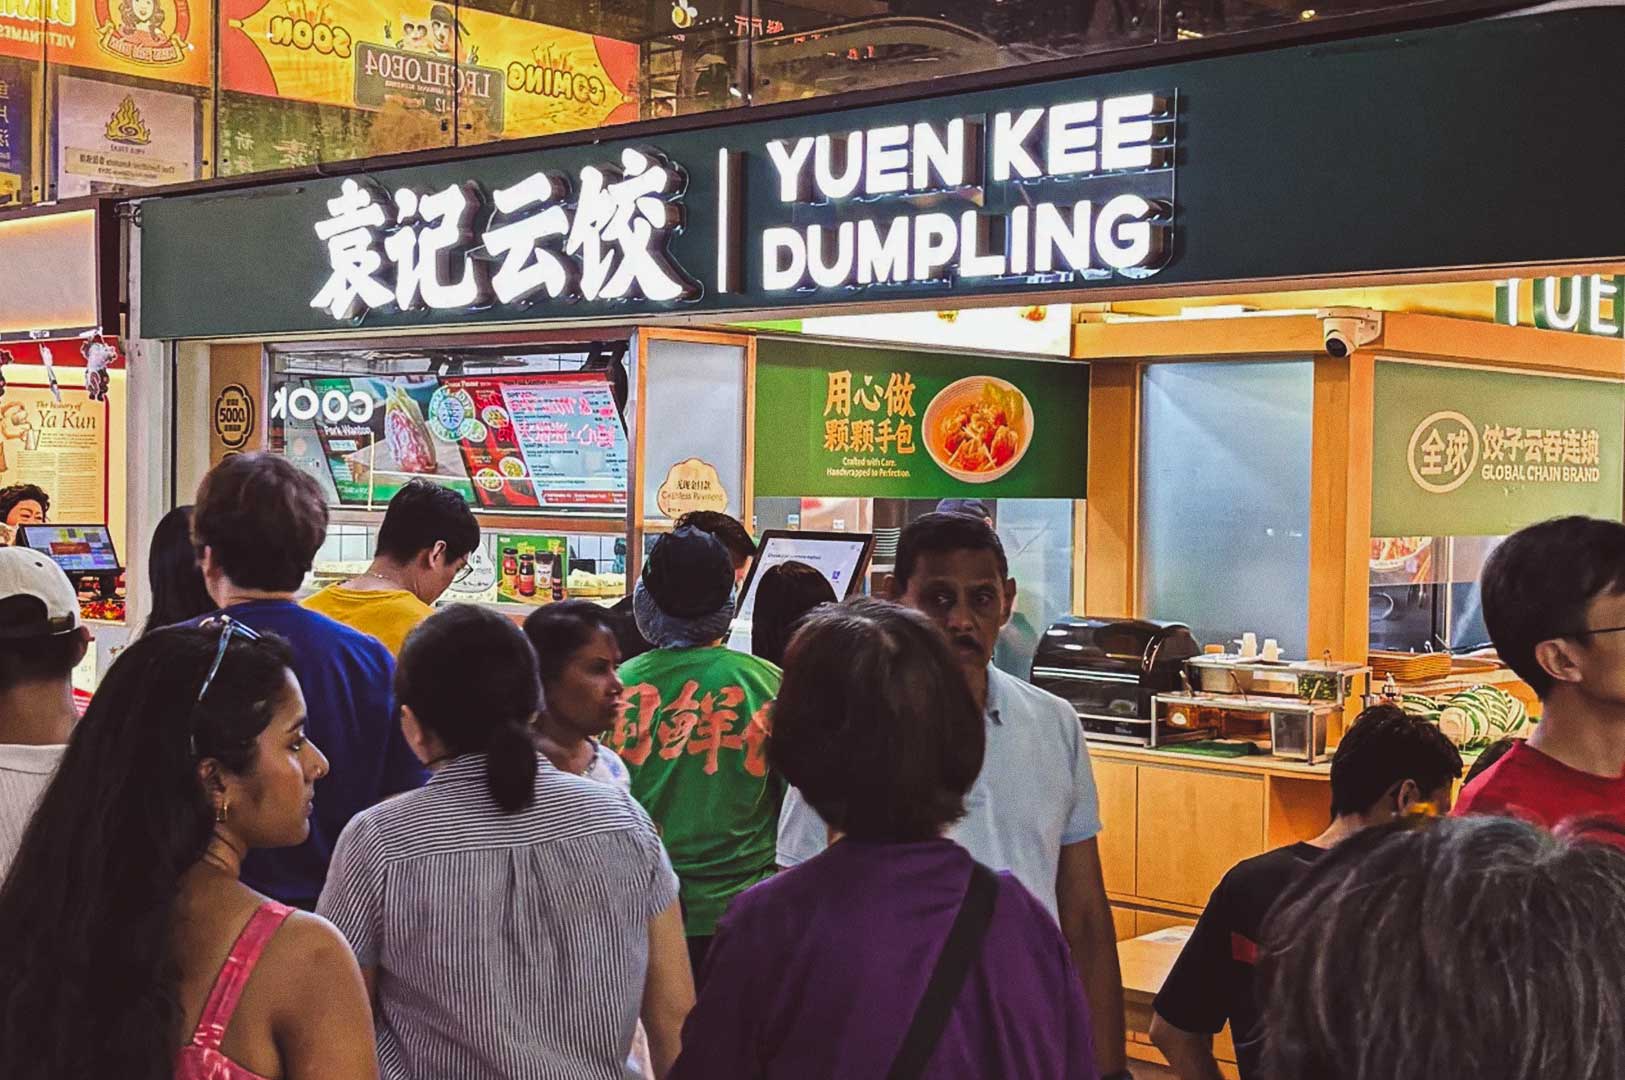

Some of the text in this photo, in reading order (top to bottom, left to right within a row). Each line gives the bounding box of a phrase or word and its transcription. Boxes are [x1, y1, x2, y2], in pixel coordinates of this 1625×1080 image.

[766, 93, 1154, 203] YUEN KEE
[309, 147, 683, 321] 袁记云饺
[761, 193, 1151, 292] DUMPLING
[823, 369, 917, 417] 用心做
[38, 410, 97, 429] Ya Kun
[823, 417, 917, 454] 颗颗手包
[842, 456, 866, 466] Crafted
[866, 457, 881, 466] with
[1419, 427, 1470, 477] 全球
[1482, 423, 1601, 465] 饺子云吞连锁
[1481, 464, 1601, 483] GLOBAL CHAIN BRAND
